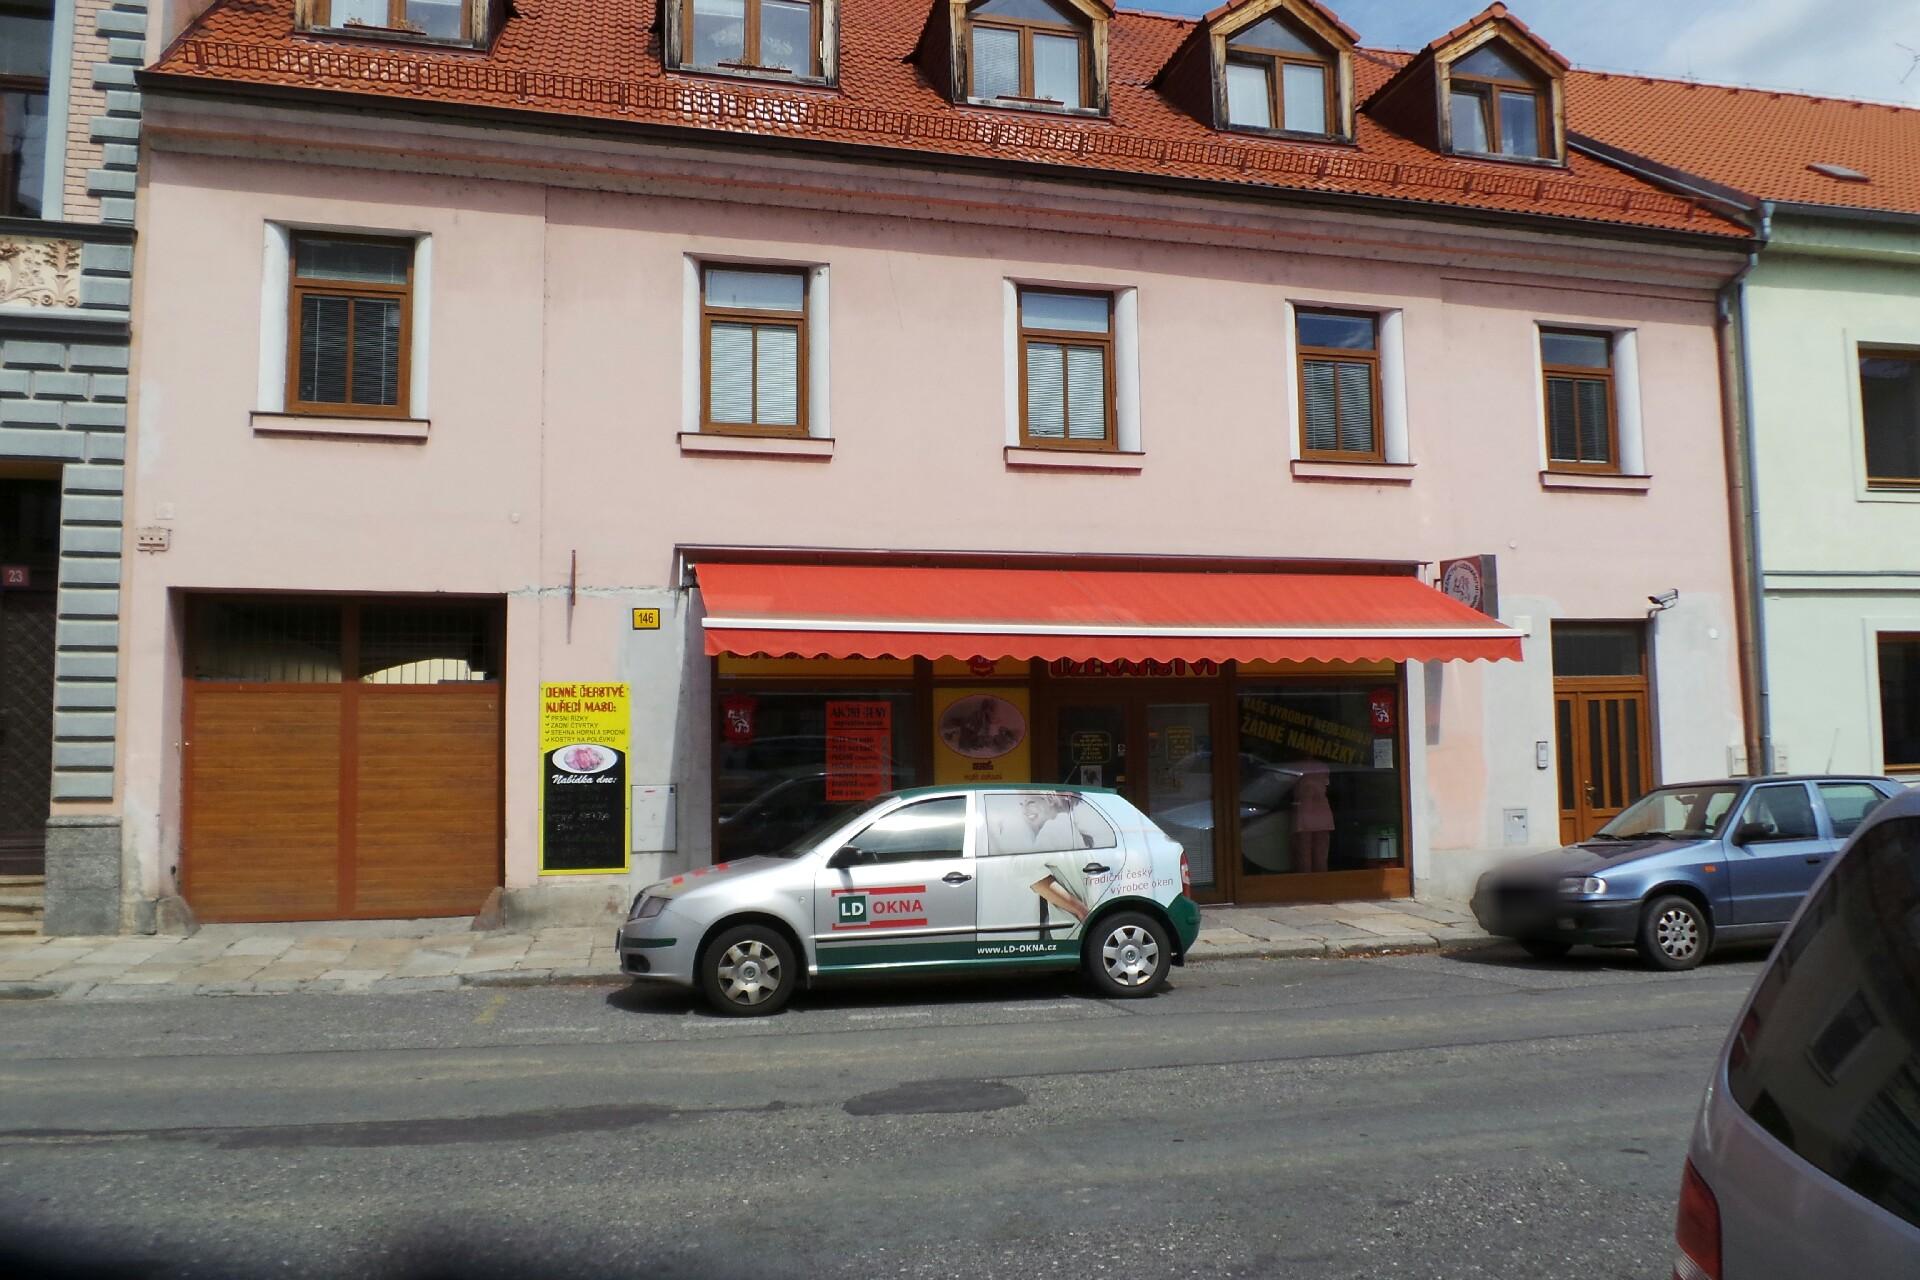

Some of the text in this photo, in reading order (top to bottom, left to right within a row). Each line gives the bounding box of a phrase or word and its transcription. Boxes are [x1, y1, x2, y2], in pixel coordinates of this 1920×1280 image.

[8, 569, 23, 583] 23
[638, 612, 654, 624] 146
[546, 684, 625, 698] DENNĚ ČERSTVÉ
[546, 699, 617, 713] KUŘECÍ MASO:
[552, 774, 618, 785] Nabídka dne:
[1083, 865, 1153, 887] Tradiční český
[1110, 878, 1174, 895] výrobce oken
[841, 899, 923, 916] LD OKNA
[977, 944, 1057, 954] www.LD-OKNA.cz
